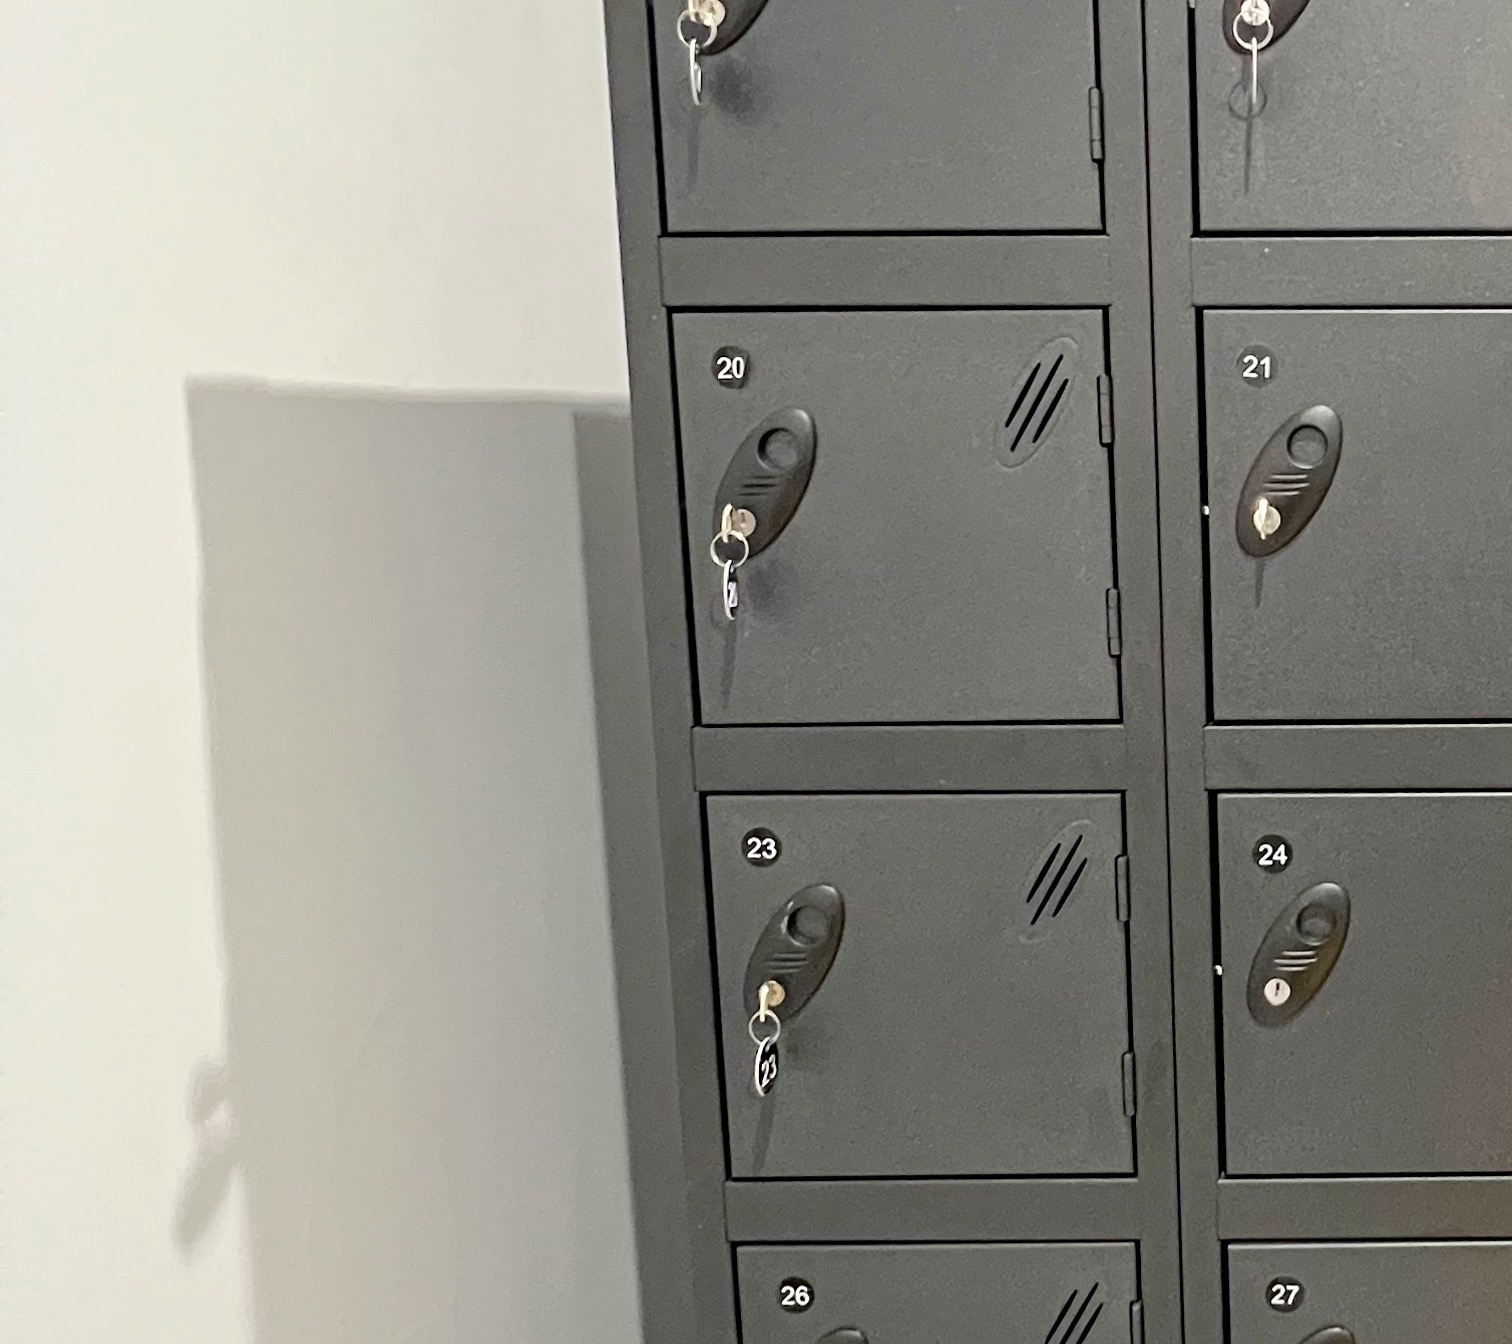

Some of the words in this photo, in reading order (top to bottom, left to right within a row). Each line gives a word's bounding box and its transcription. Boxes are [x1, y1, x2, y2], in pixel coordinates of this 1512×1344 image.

[716, 356, 745, 379] 20
[1242, 354, 1271, 379] 21
[747, 837, 777, 860] 23
[1258, 843, 1288, 866] 24
[760, 1053, 778, 1088] 23
[780, 1285, 810, 1306] 26
[1270, 1284, 1299, 1305] 27
